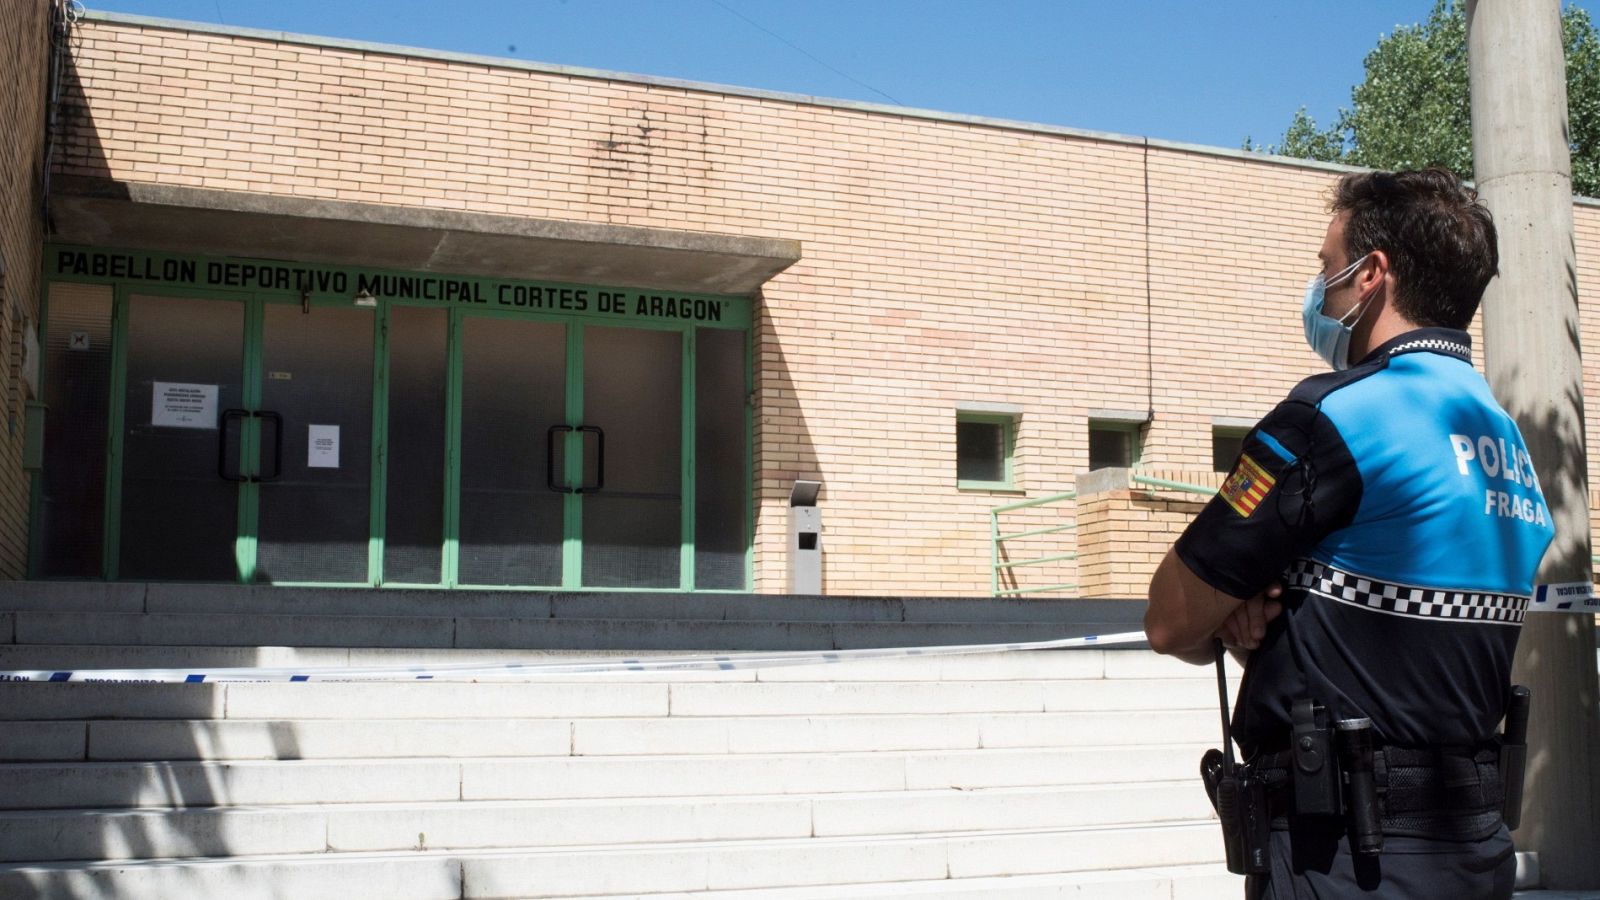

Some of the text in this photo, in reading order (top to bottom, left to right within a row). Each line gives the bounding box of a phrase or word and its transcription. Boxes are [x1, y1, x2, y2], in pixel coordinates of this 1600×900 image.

[57, 251, 196, 283] PABELLON
[207, 261, 348, 293] DEPORTIVO
[357, 273, 487, 304] MUNICIPAL
[598, 291, 626, 314] DE
[1485, 489, 1547, 527] FRAGA
